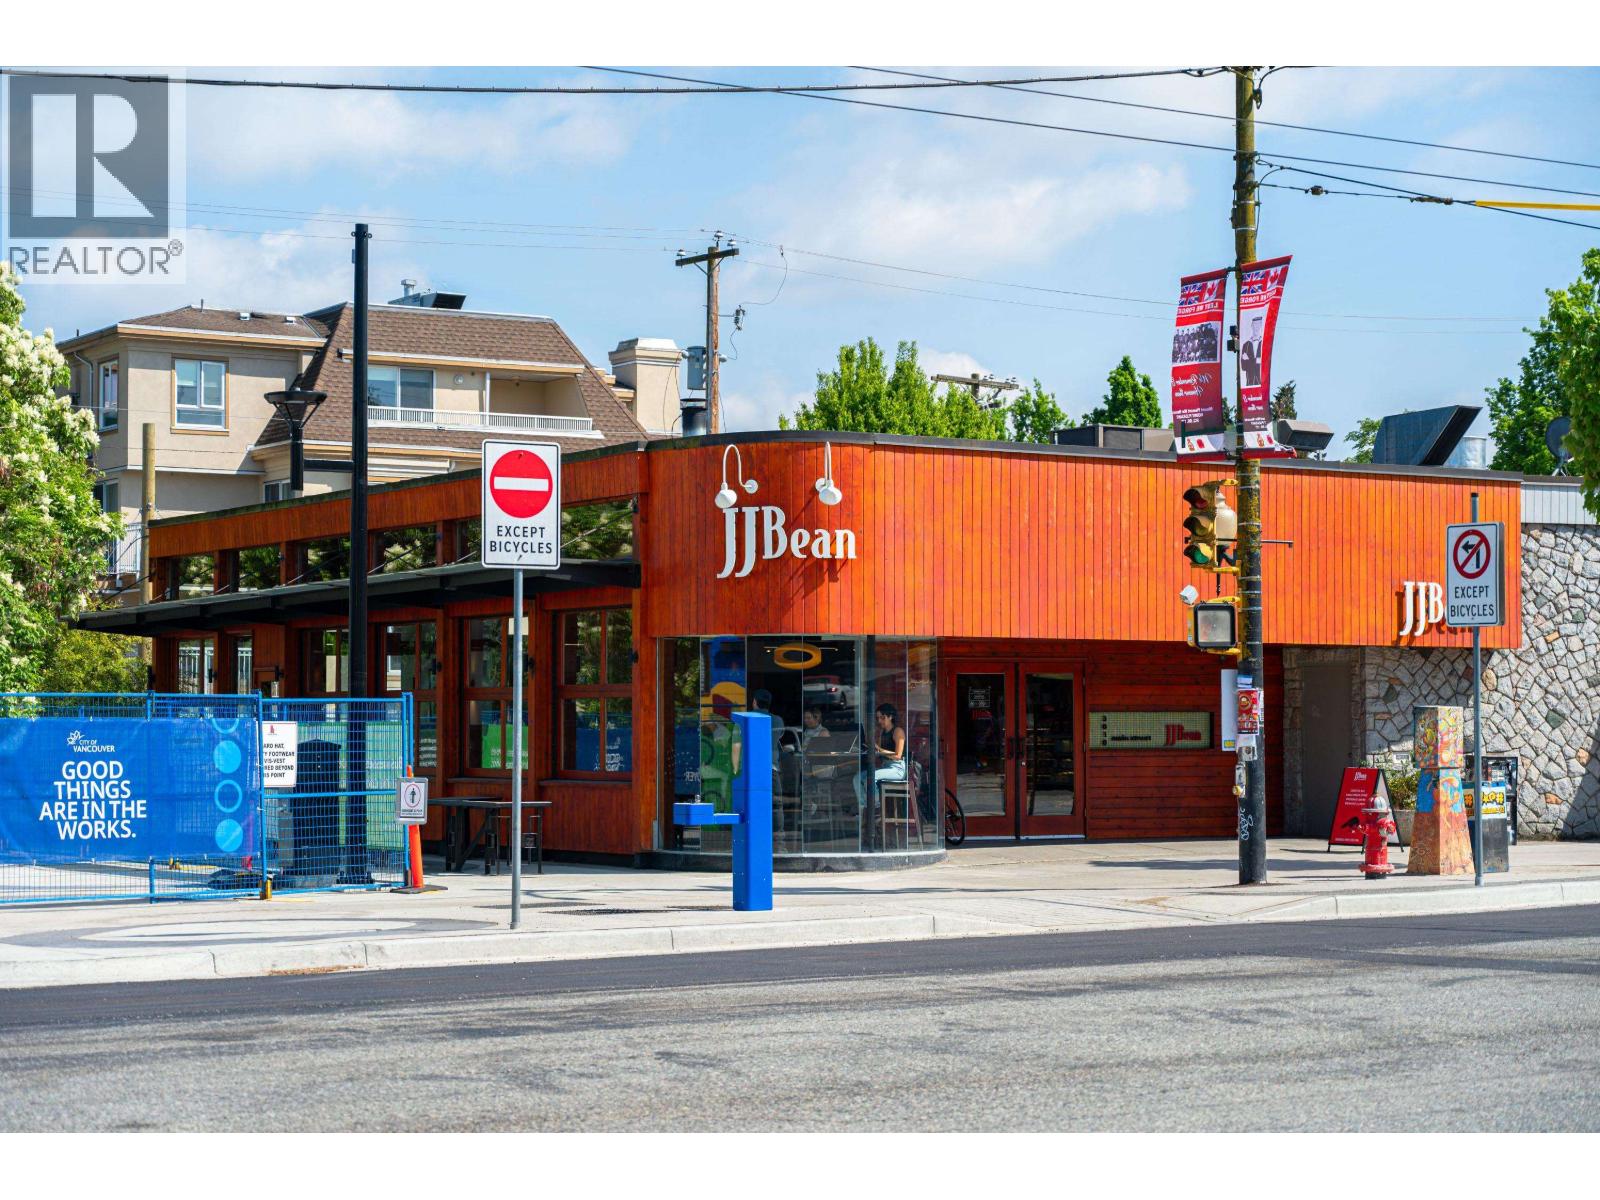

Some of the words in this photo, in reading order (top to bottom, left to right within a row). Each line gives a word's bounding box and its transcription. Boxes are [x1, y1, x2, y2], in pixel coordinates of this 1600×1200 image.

[497, 525, 545, 538] EXCEPT
[716, 505, 857, 578] JJBean
[489, 540, 552, 554] BICYCLES
[1454, 586, 1489, 598] EXCEPT
[1399, 581, 1446, 636] JJB
[1450, 604, 1494, 617] BICYCLES
[62, 760, 123, 780] GOOD
[53, 780, 131, 800] THINGS
[39, 801, 78, 820] ARE
[82, 800, 105, 819] IN
[109, 799, 147, 819] THE
[57, 819, 136, 840] WORKS.
